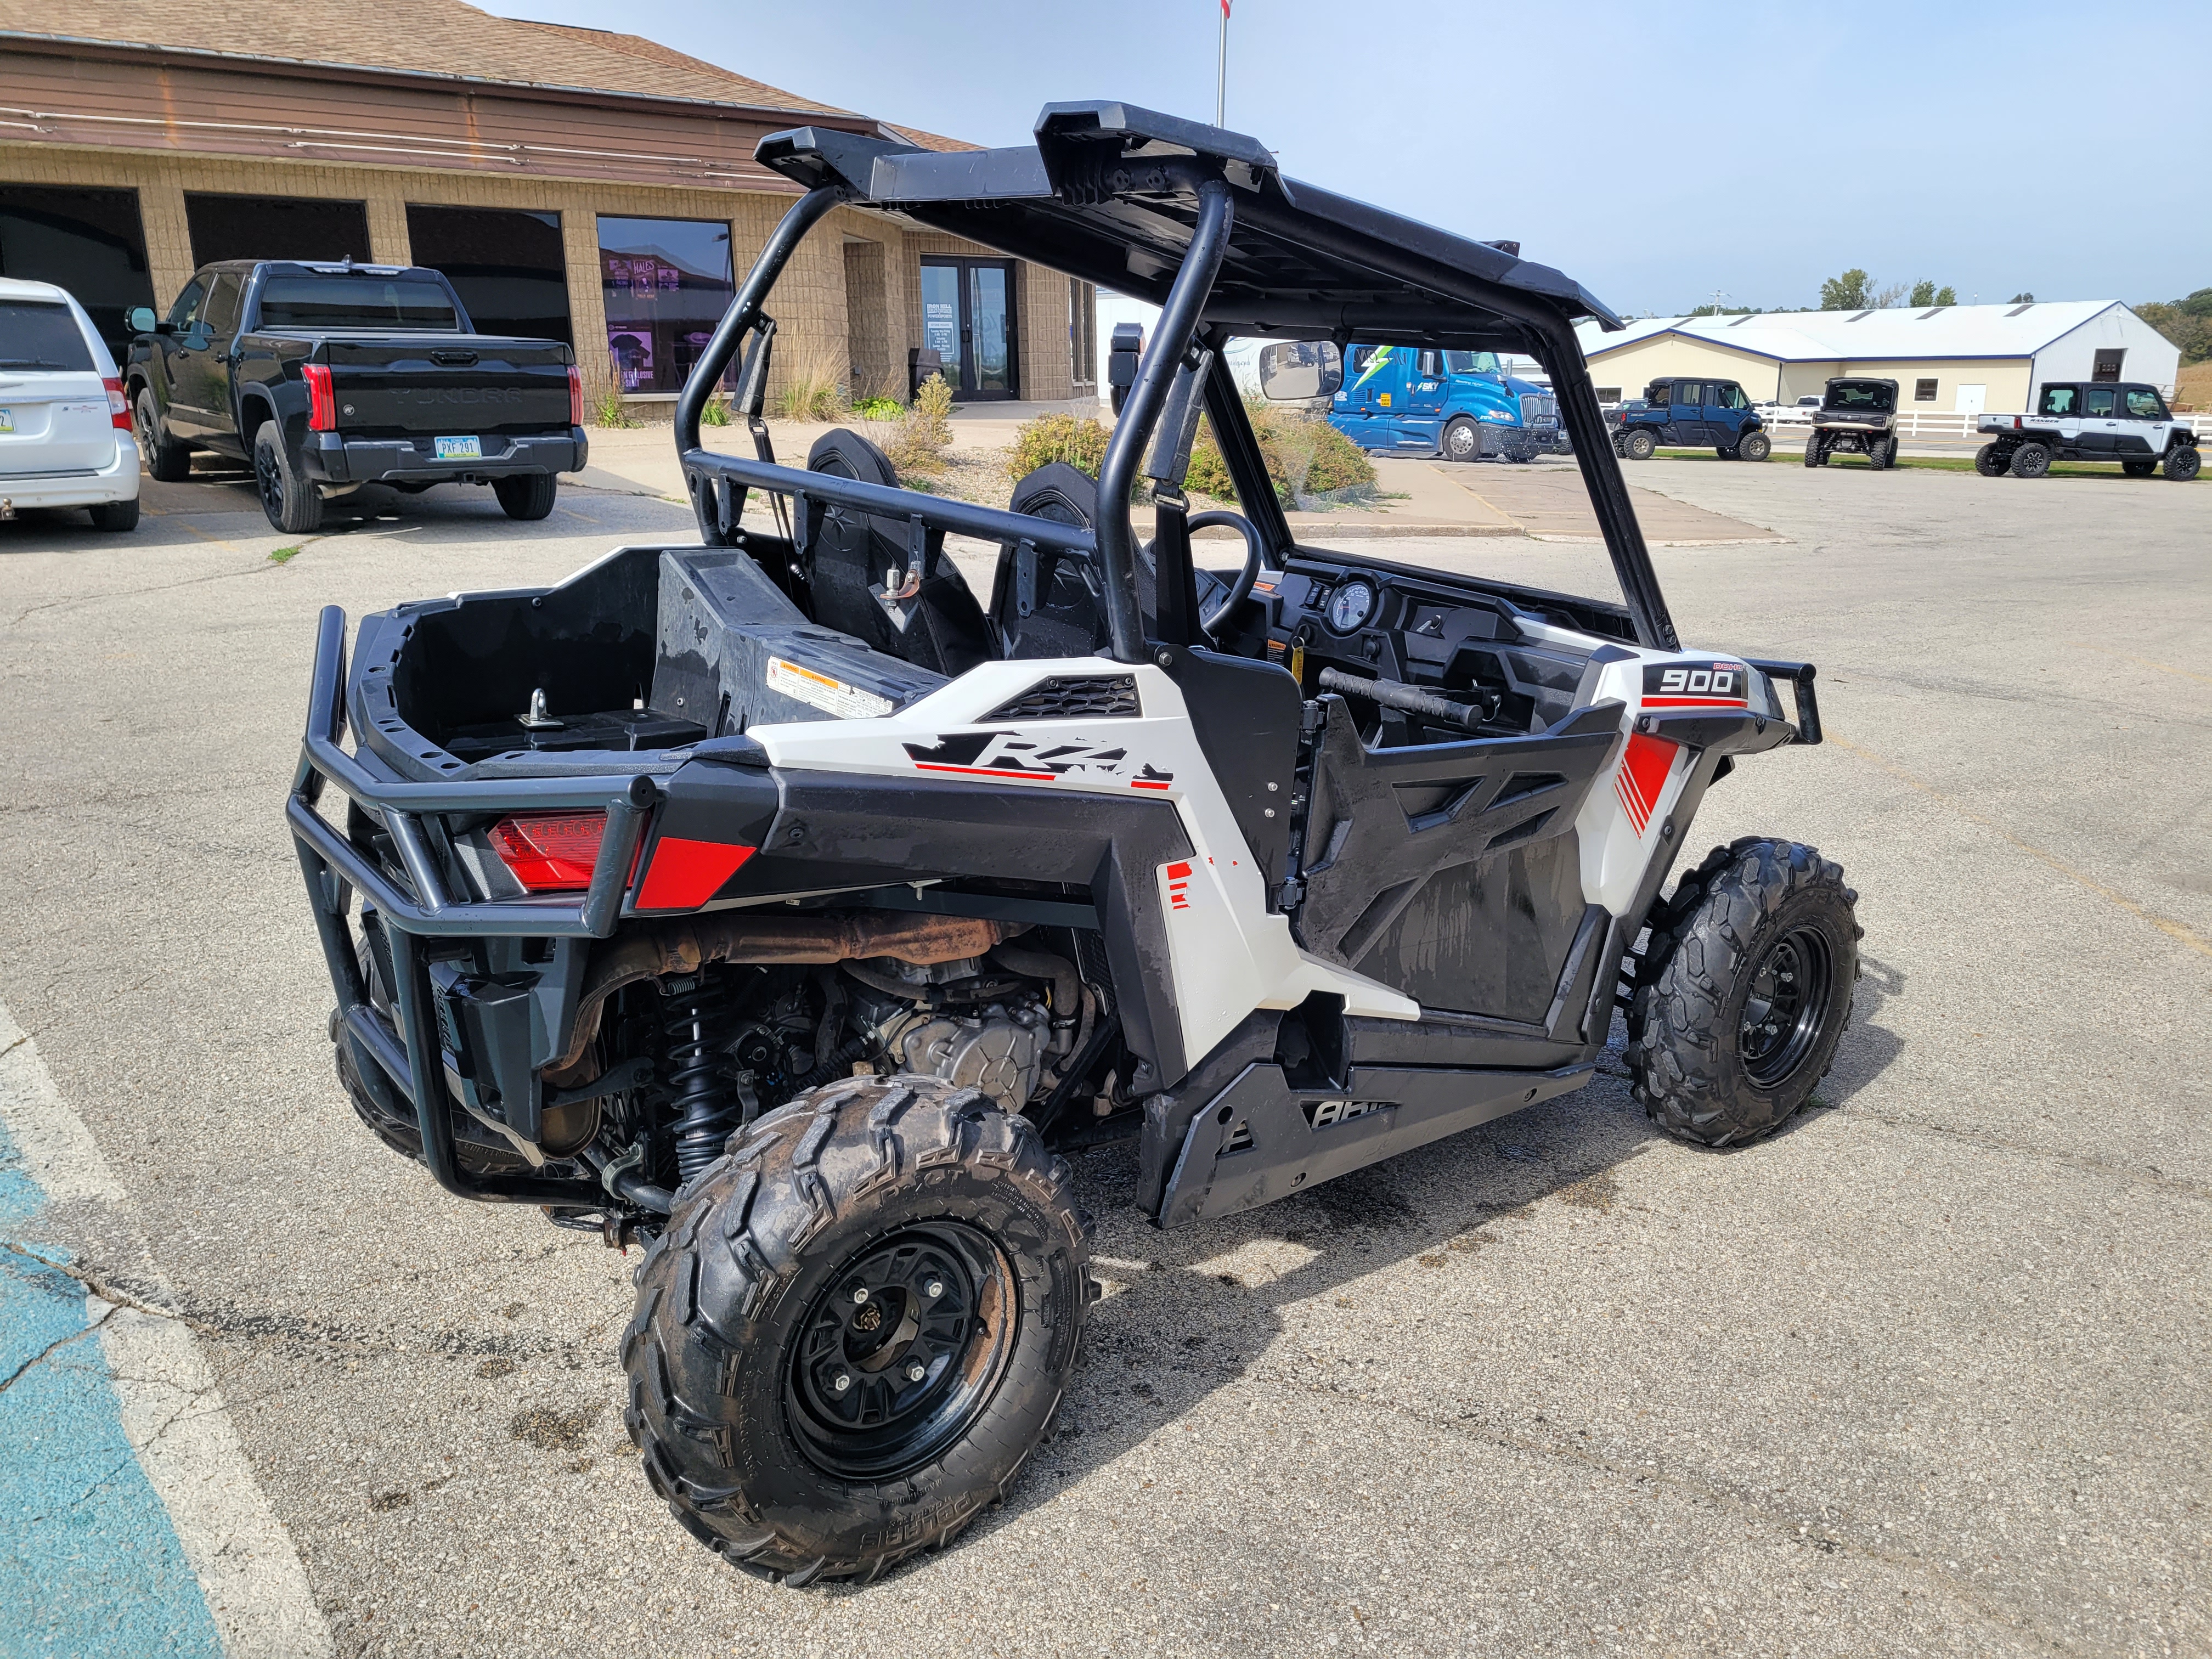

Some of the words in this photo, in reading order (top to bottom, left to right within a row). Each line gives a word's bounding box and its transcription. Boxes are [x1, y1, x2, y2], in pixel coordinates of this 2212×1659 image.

[1422, 382, 1438, 390] SKY
[389, 388, 522, 403] TUNDRA
[442, 443, 455, 453] PXF
[460, 443, 474, 453] 291
[1713, 663, 1743, 671] DOHC
[1660, 670, 1733, 692] 900
[859, 1490, 975, 1550] POLARIS
